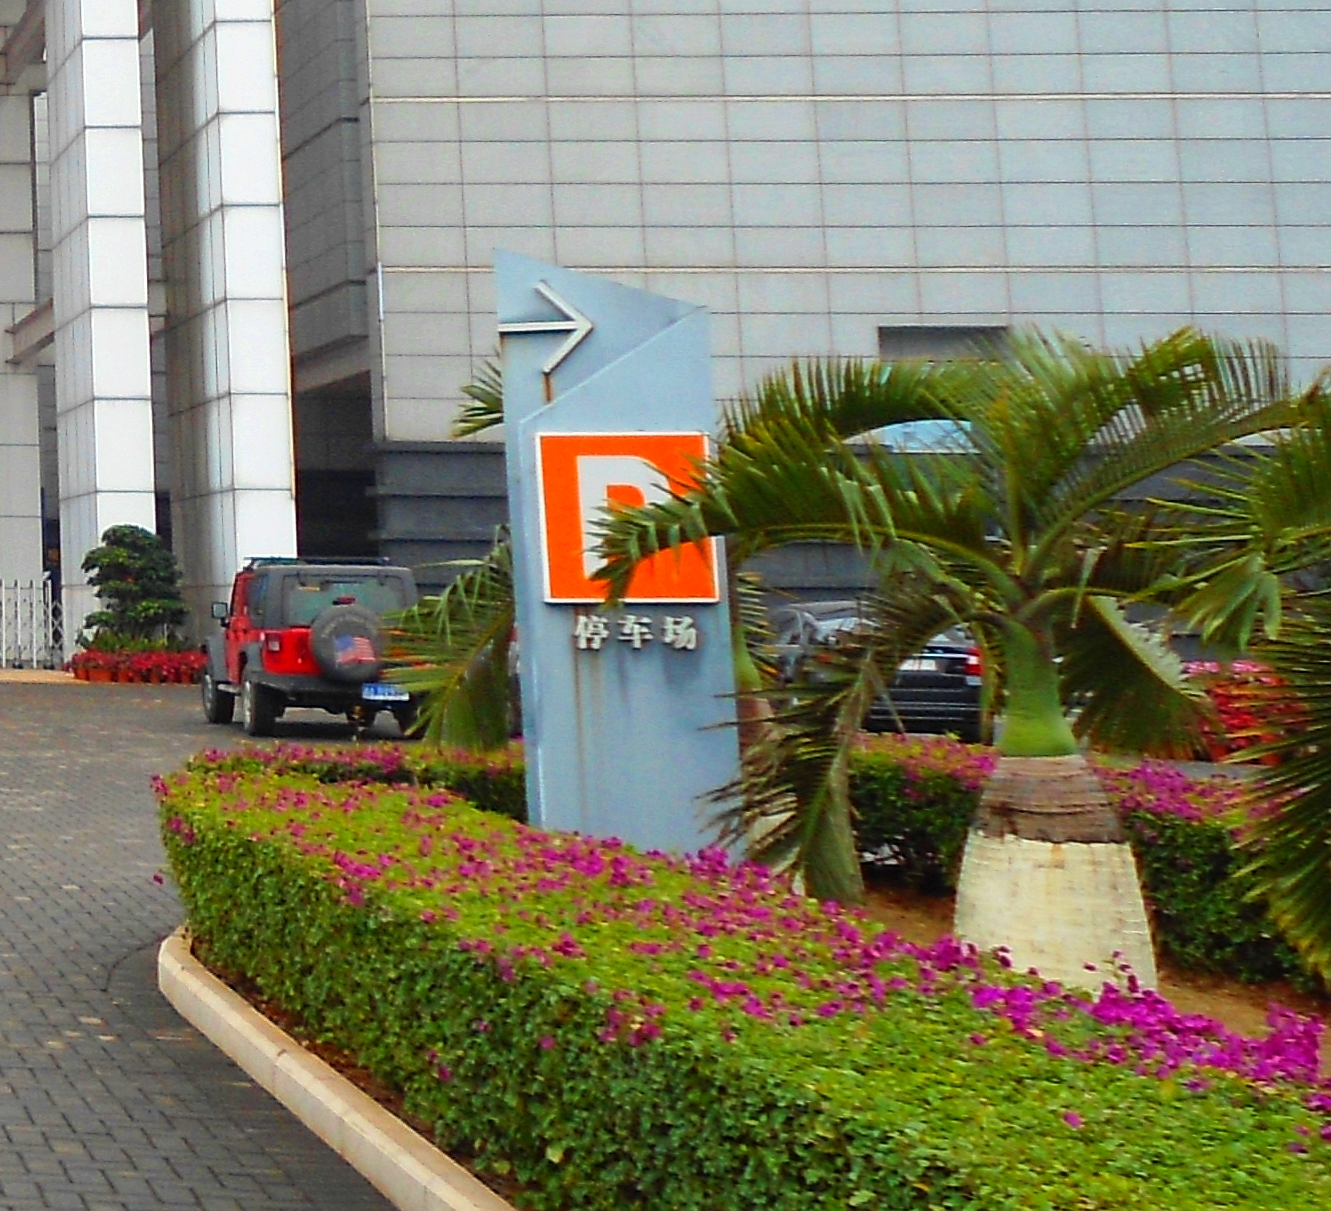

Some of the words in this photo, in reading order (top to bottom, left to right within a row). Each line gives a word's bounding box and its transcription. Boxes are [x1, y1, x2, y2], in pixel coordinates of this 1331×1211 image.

[576, 455, 674, 581] P
[573, 614, 698, 650] 停车场
